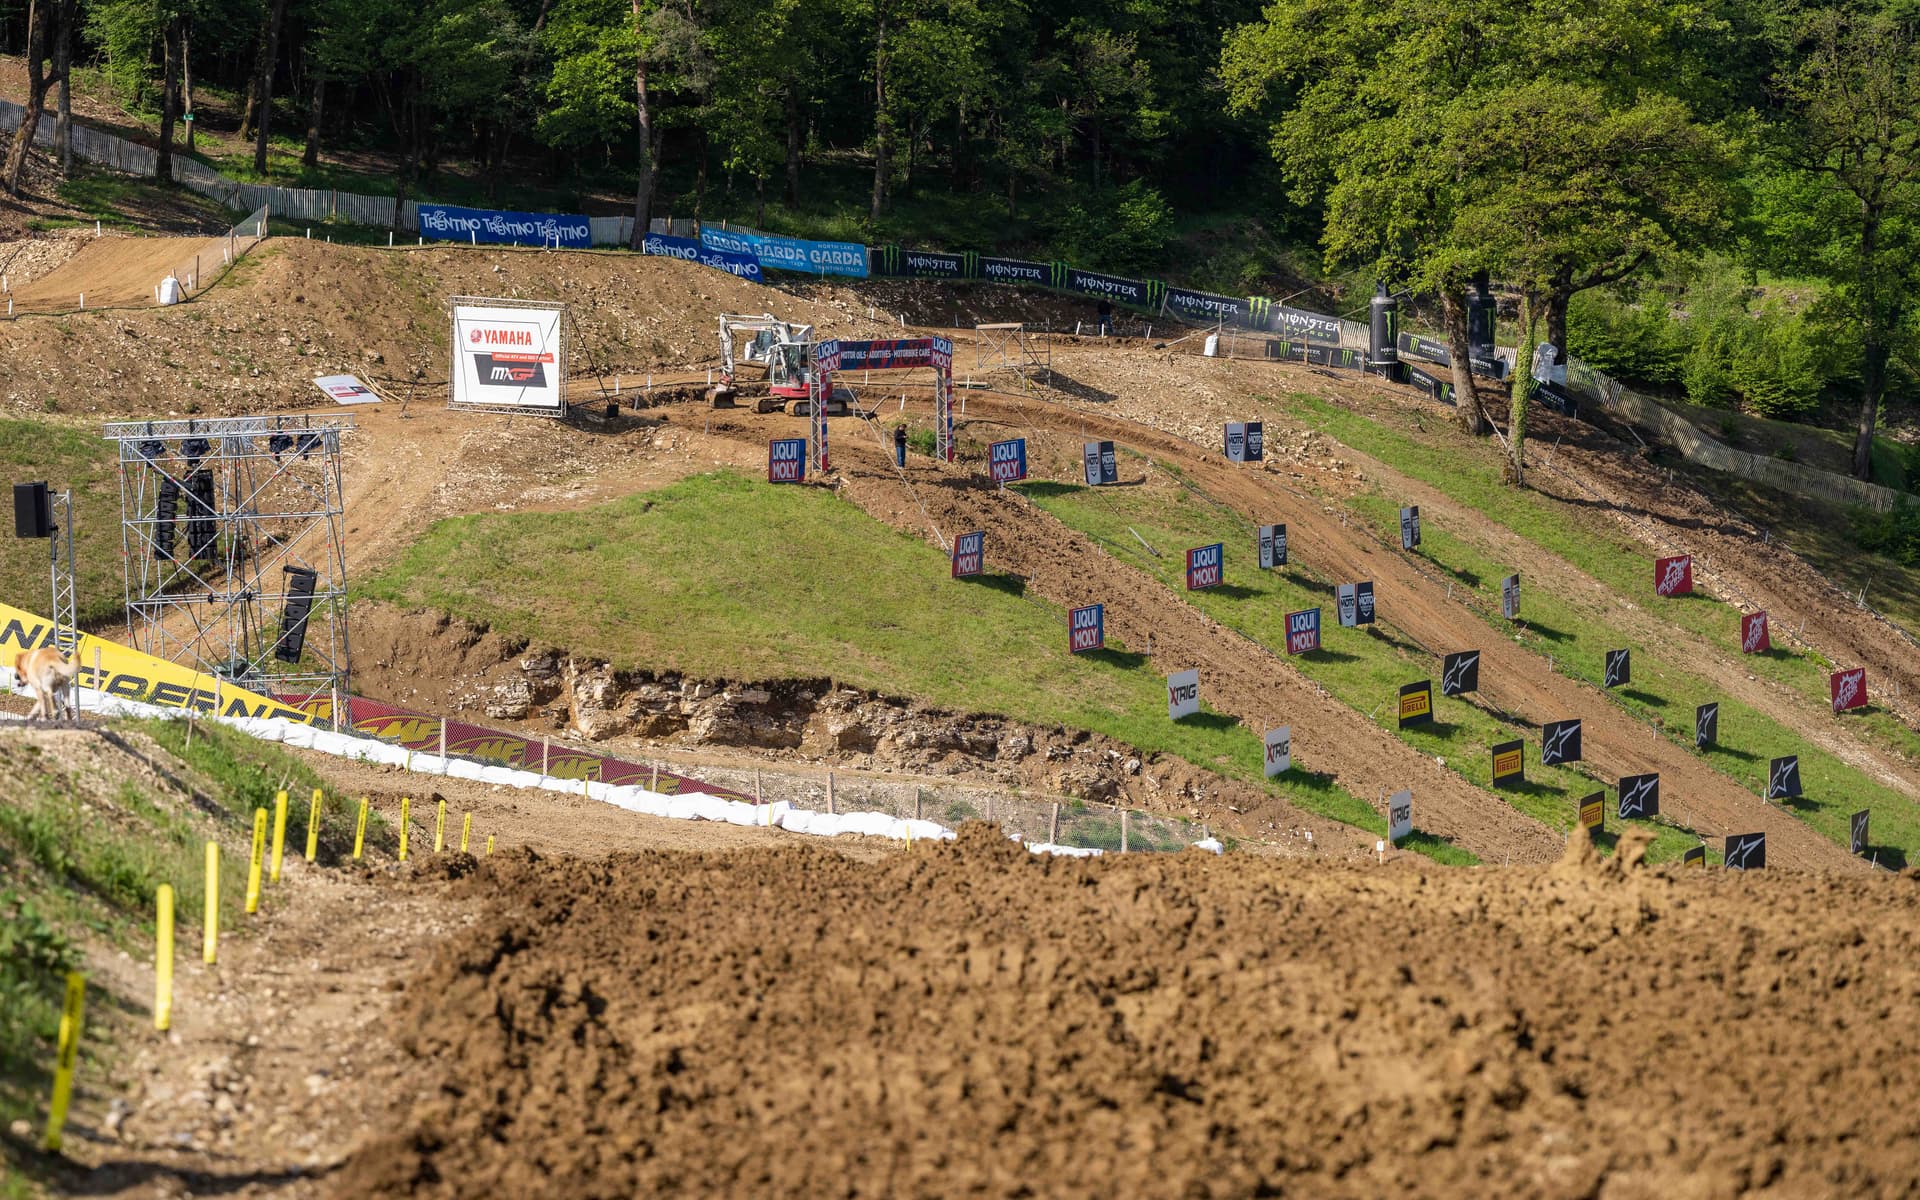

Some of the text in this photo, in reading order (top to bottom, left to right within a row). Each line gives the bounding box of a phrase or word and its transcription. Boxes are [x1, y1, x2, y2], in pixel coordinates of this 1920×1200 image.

[421, 212, 588, 240] TRENTINO TRENTINO TRENTINO
[702, 233, 752, 253] GARDA
[754, 243, 807, 262] GARDA
[810, 249, 863, 266] GARDA
[908, 256, 957, 271] MONSTER
[985, 263, 1043, 280] MONSTER
[1076, 275, 1138, 297] MONSTER
[1175, 294, 1239, 315] MONSTER
[1277, 311, 1341, 333] MONSTER
[483, 329, 533, 346] YAMAHA
[932, 336, 953, 355] LIQUI
[818, 340, 839, 359] LIQUI
[819, 354, 840, 373] MOLY
[932, 350, 952, 370] MOLY
[773, 442, 797, 460] LIQUI
[992, 443, 1017, 462] LIQUI
[773, 461, 798, 479] MOLY
[993, 461, 1018, 481] MOLY
[960, 535, 979, 555] LIQUI
[959, 554, 978, 574] MOLY
[1193, 548, 1217, 568] LIQUI
[1193, 566, 1218, 587] MOLY
[1074, 609, 1097, 629] LIQUI
[1291, 612, 1315, 633] LIQUI
[1075, 628, 1097, 649] MOLY
[1292, 631, 1316, 652] MOLY
[1169, 683, 1197, 706] XTRIG
[1402, 695, 1426, 713] PIRELLI
[1266, 740, 1290, 764] XTRIG
[1496, 754, 1519, 774] PIRELLI
[1389, 804, 1410, 828] XTRIG
